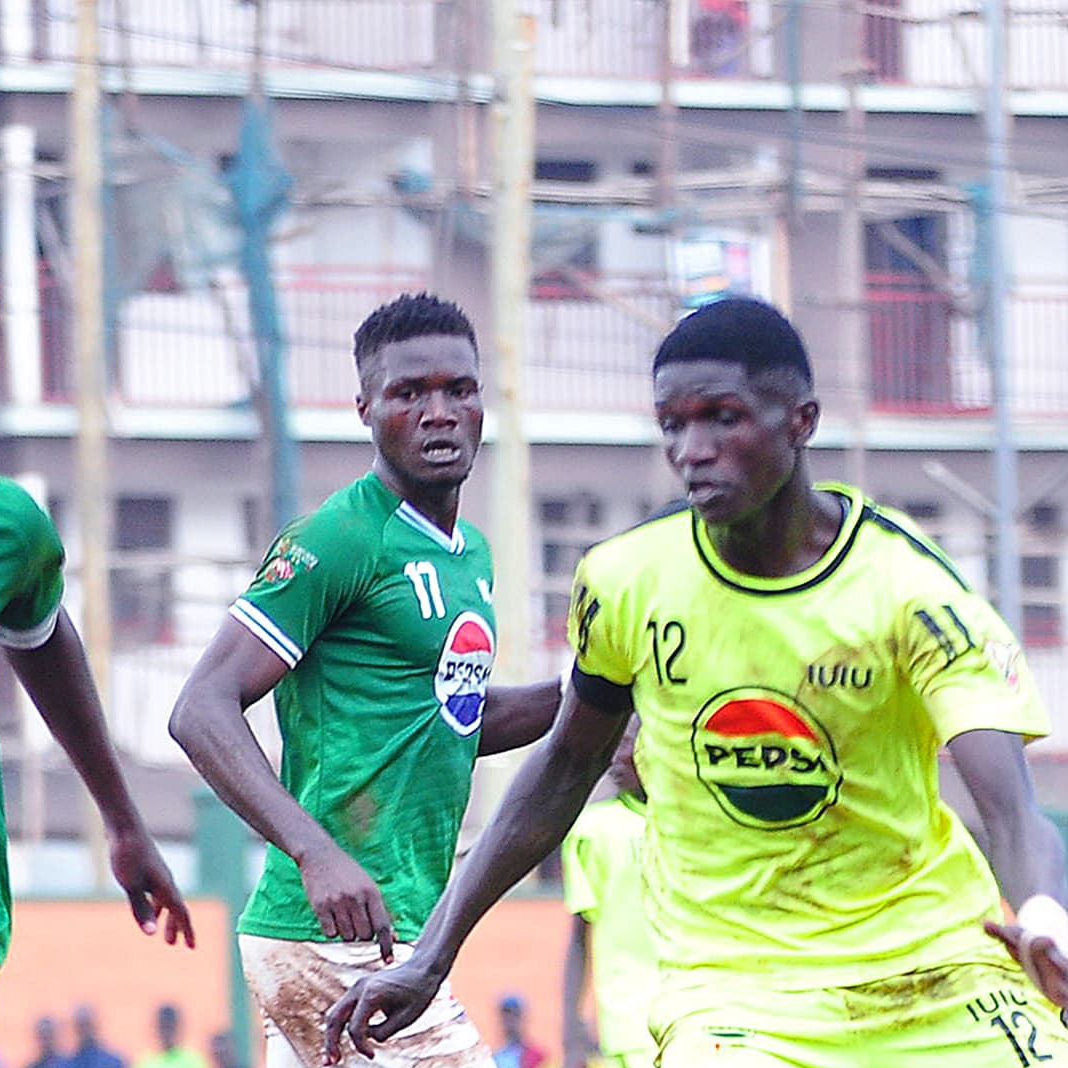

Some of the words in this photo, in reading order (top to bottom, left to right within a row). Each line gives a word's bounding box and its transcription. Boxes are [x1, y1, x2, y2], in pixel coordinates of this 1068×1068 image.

[646, 620, 688, 685] 12
[808, 664, 872, 689] IUIU
[704, 744, 827, 773] PEPSI
[991, 1011, 1053, 1068] 12
